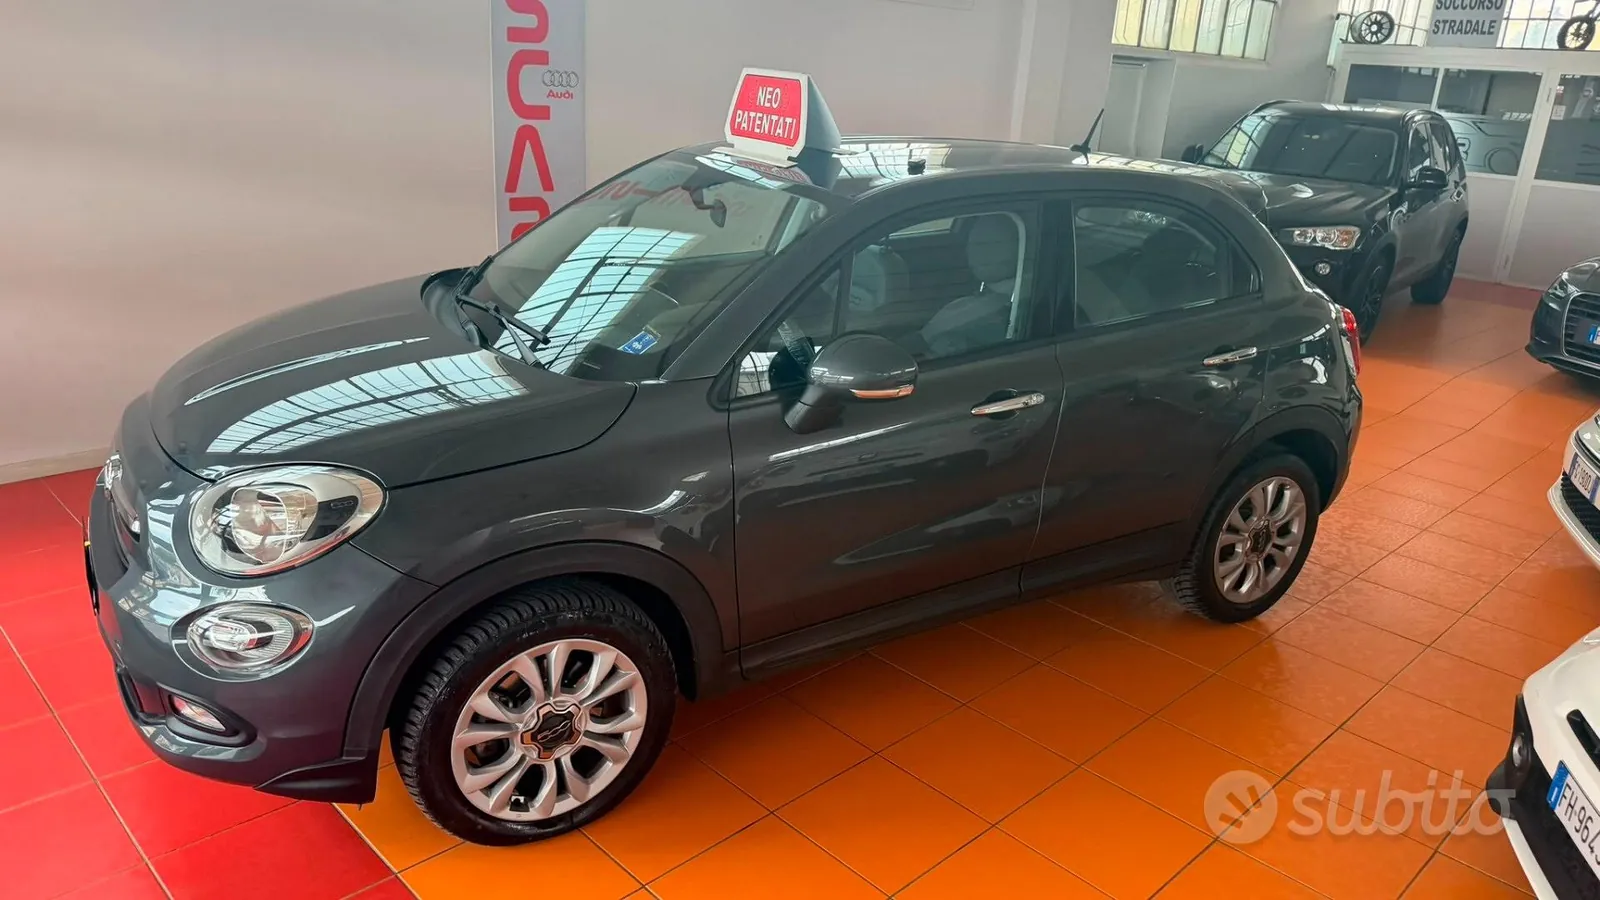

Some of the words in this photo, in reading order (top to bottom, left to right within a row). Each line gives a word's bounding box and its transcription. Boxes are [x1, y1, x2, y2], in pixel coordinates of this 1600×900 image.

[1435, 0, 1504, 10] SOCCORSO
[1432, 19, 1497, 35] STRADALE
[546, 89, 574, 99] Audi
[757, 86, 781, 108] NEO
[735, 109, 797, 139] PATENTATI
